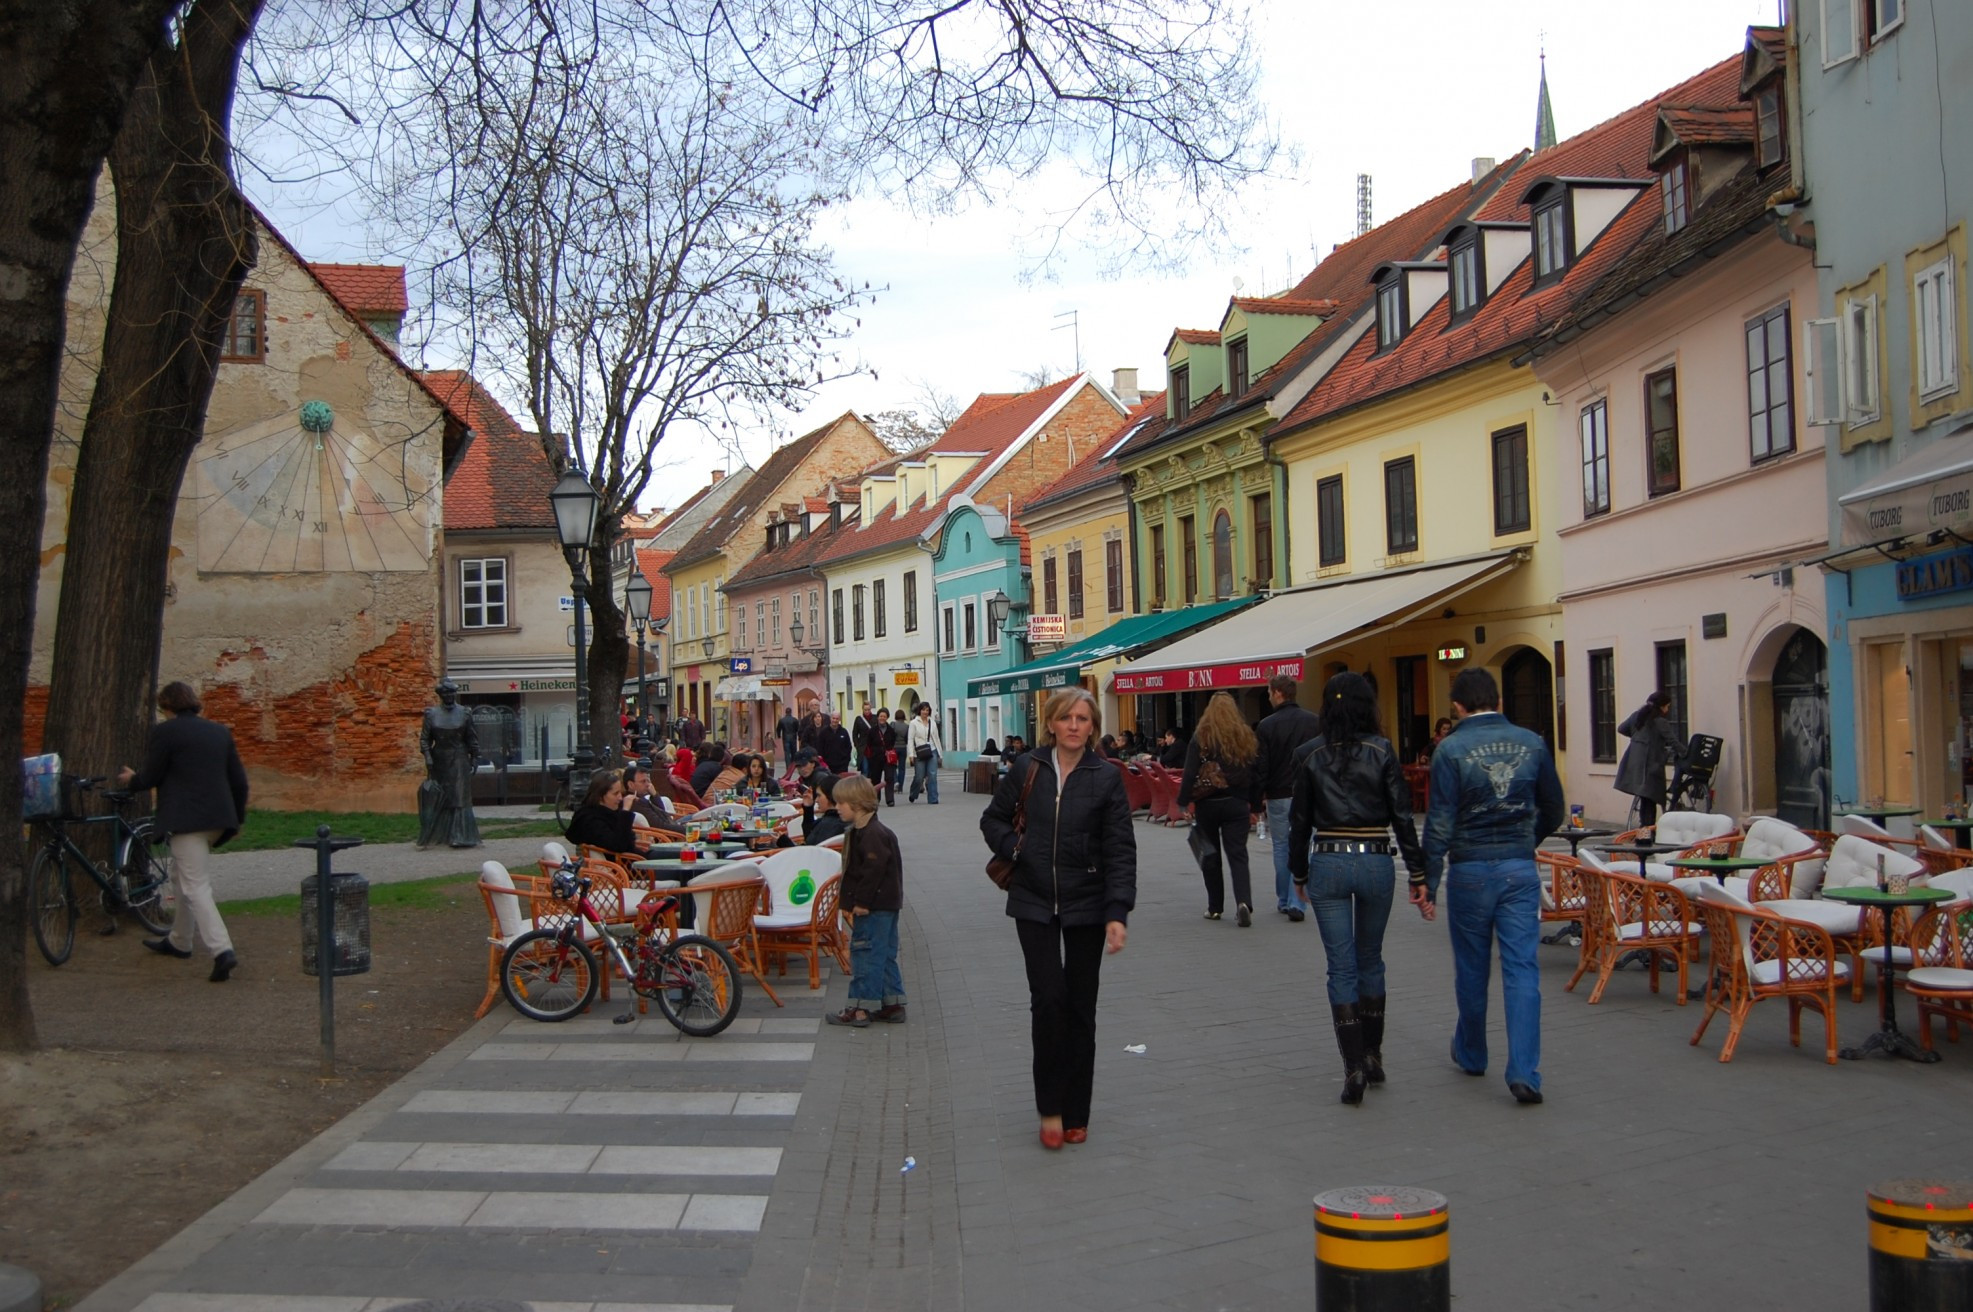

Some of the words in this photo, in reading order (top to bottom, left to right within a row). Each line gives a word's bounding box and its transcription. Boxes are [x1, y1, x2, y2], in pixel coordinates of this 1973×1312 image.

[1933, 489, 1970, 516] TUBORG
[1870, 506, 1903, 530] TUBORG
[313, 521, 328, 534] XII
[1033, 616, 1062, 624] KEMIJSKA
[1033, 624, 1063, 633] ČISTIONICA
[1116, 678, 1134, 689] STELLA
[1145, 676, 1163, 688] ARTOIS
[1239, 667, 1261, 680] STELLA
[1276, 663, 1299, 676] ARTOIS
[520, 680, 577, 691] Heineken
